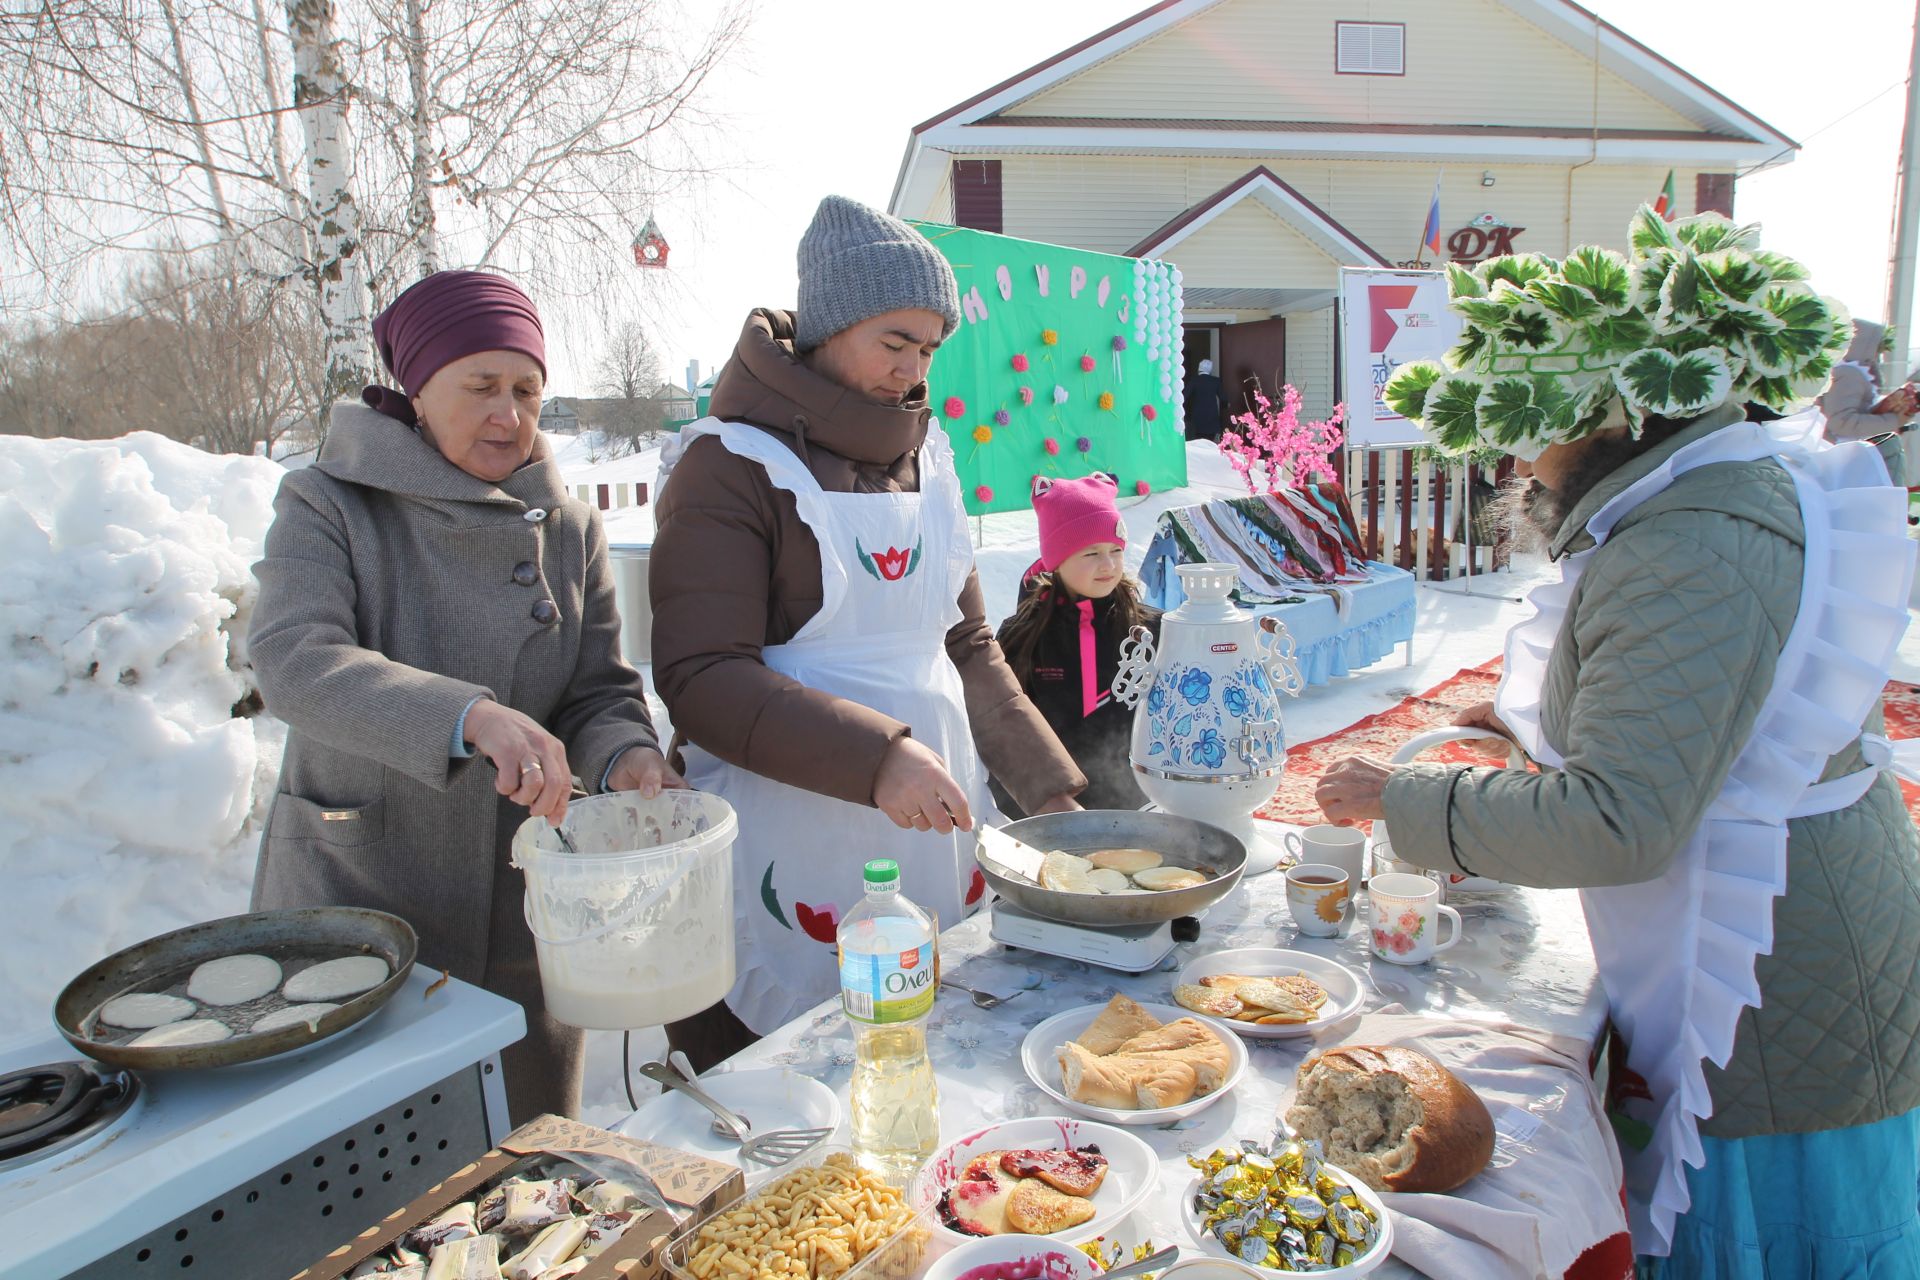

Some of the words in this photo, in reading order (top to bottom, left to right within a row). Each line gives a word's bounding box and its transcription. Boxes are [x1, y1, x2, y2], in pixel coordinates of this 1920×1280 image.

[1372, 368, 1389, 384] 20
[865, 882, 896, 892] Олейна
[885, 960, 933, 993] Олей
